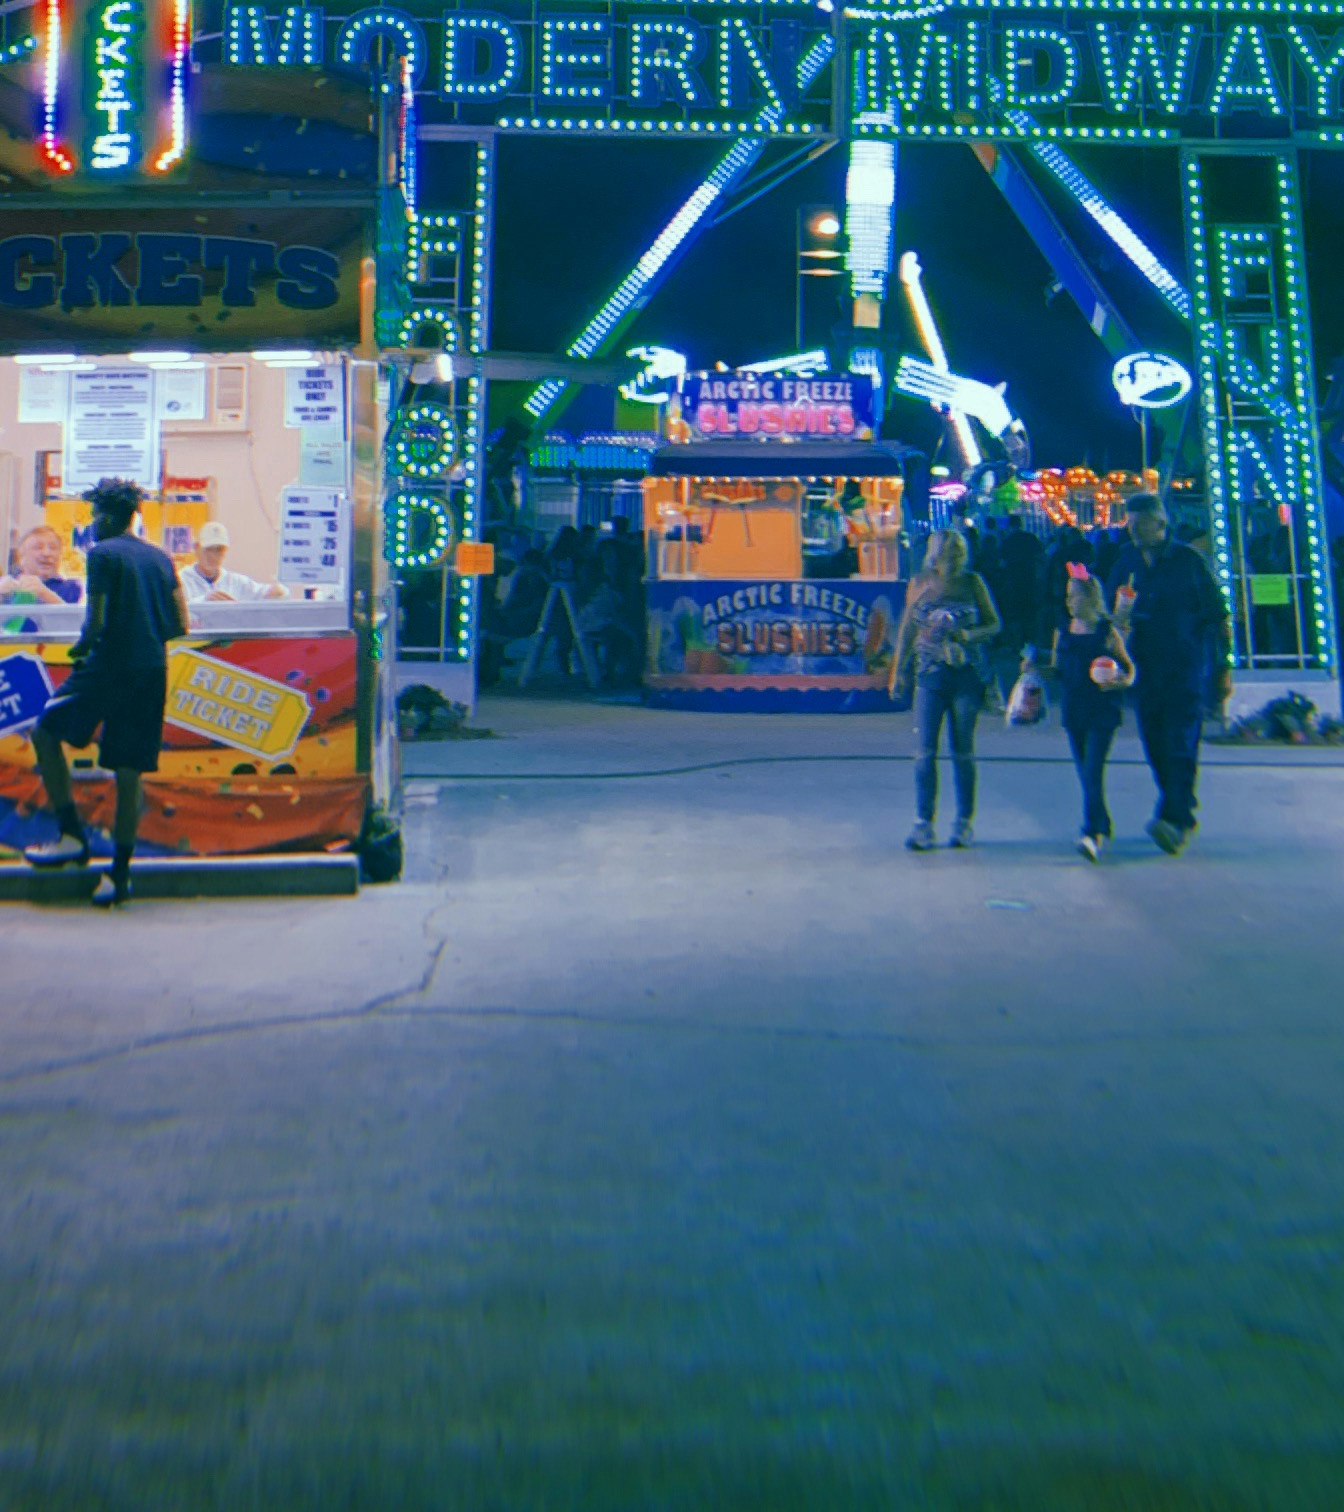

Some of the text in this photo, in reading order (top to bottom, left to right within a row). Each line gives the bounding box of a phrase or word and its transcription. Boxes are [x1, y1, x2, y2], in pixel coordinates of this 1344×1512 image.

[223, 5, 802, 110] MODERN
[698, 380, 854, 401] ARCTIC FREEZE
[1214, 226, 1299, 504] FUN
[703, 583, 868, 627] ARCTIC FREEZE
[171, 689, 272, 740] TICKET
[189, 663, 281, 716] RIDE
